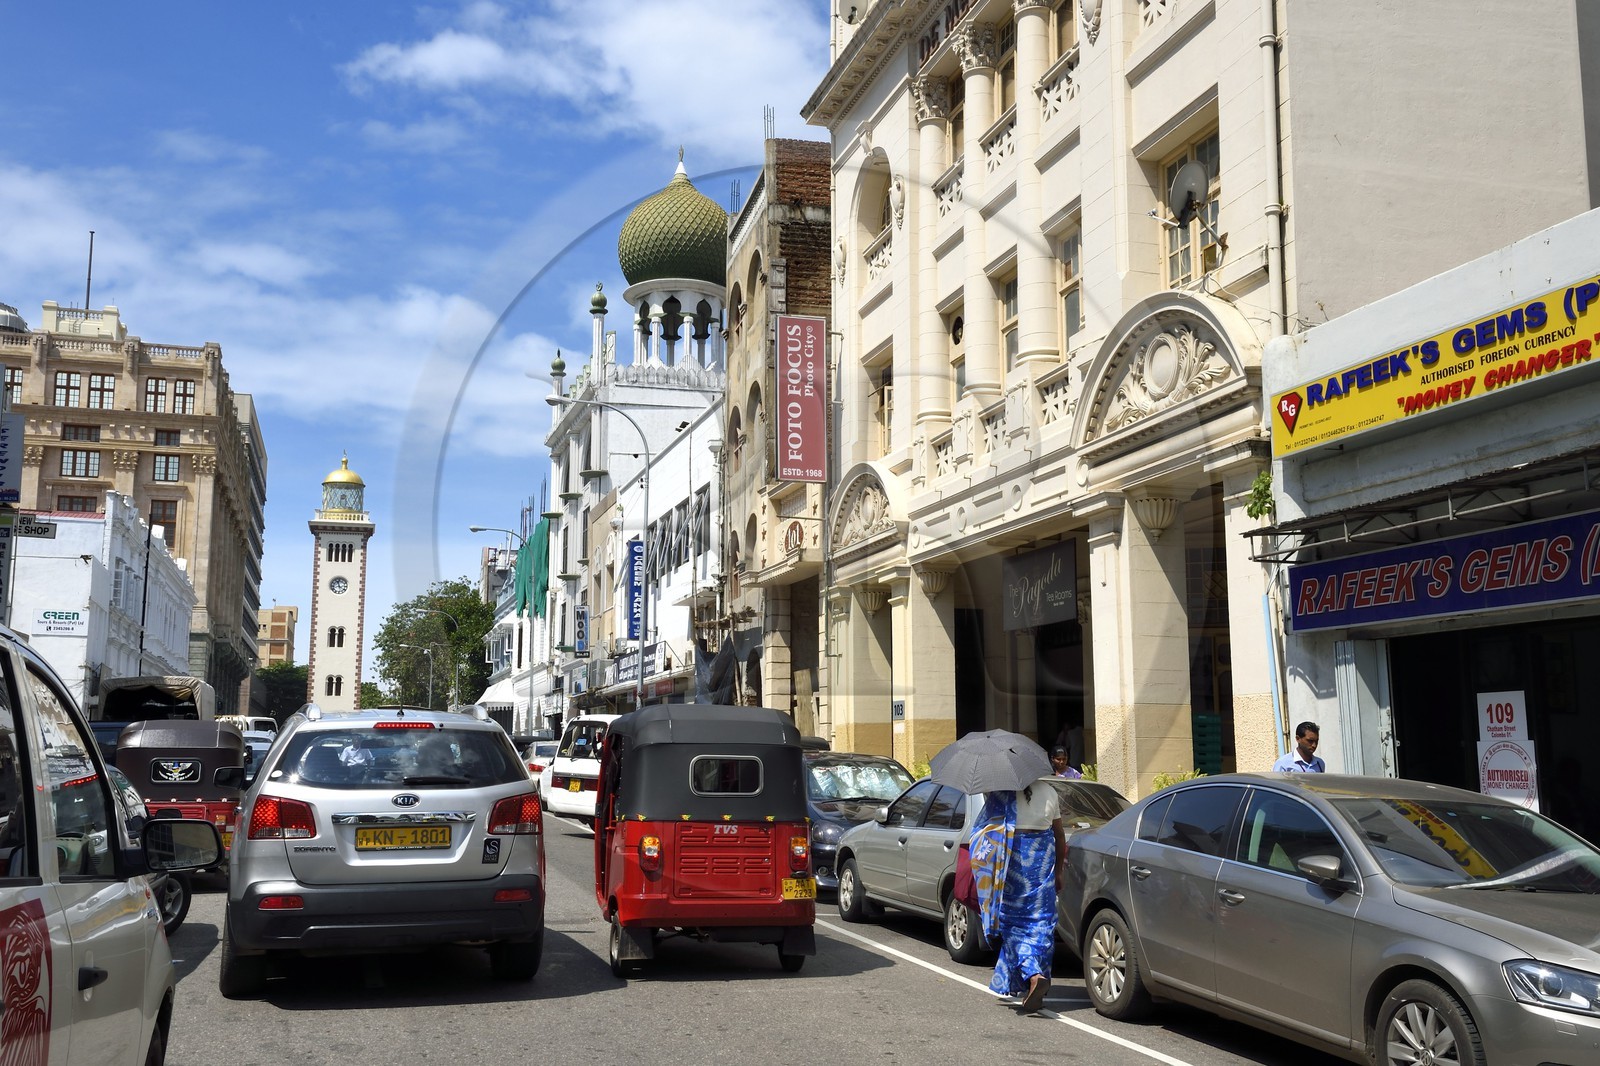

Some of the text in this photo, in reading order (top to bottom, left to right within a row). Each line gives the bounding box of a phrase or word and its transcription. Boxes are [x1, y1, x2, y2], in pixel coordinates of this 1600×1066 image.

[1306, 279, 1600, 407] RAFEEK'S GEMS (P
[1420, 324, 1577, 385] AUTHORISED FOREIGN CURRENCY
[804, 362, 814, 397] Photo
[787, 324, 802, 462] FOTO FOCUS
[1281, 399, 1296, 417] RG
[1346, 424, 1355, 432] Fax
[783, 467, 823, 477] ESTD: 1968
[24, 526, 50, 535] SHOP
[1296, 555, 1453, 616] RAFEEK'S
[1460, 535, 1573, 594] GEMS
[1012, 552, 1061, 618] Pagoda
[1046, 592, 1055, 602] Tea
[42, 611, 80, 620] GREEN
[893, 704, 904, 716] 103
[1486, 703, 1514, 724] 109
[1487, 769, 1529, 782] AUTHORISED
[1487, 782, 1530, 790] MONEY CHANGER
[714, 824, 738, 835] TVS
[373, 830, 394, 845] KN
[411, 829, 448, 844] 1801
[793, 888, 813, 898] 2223
